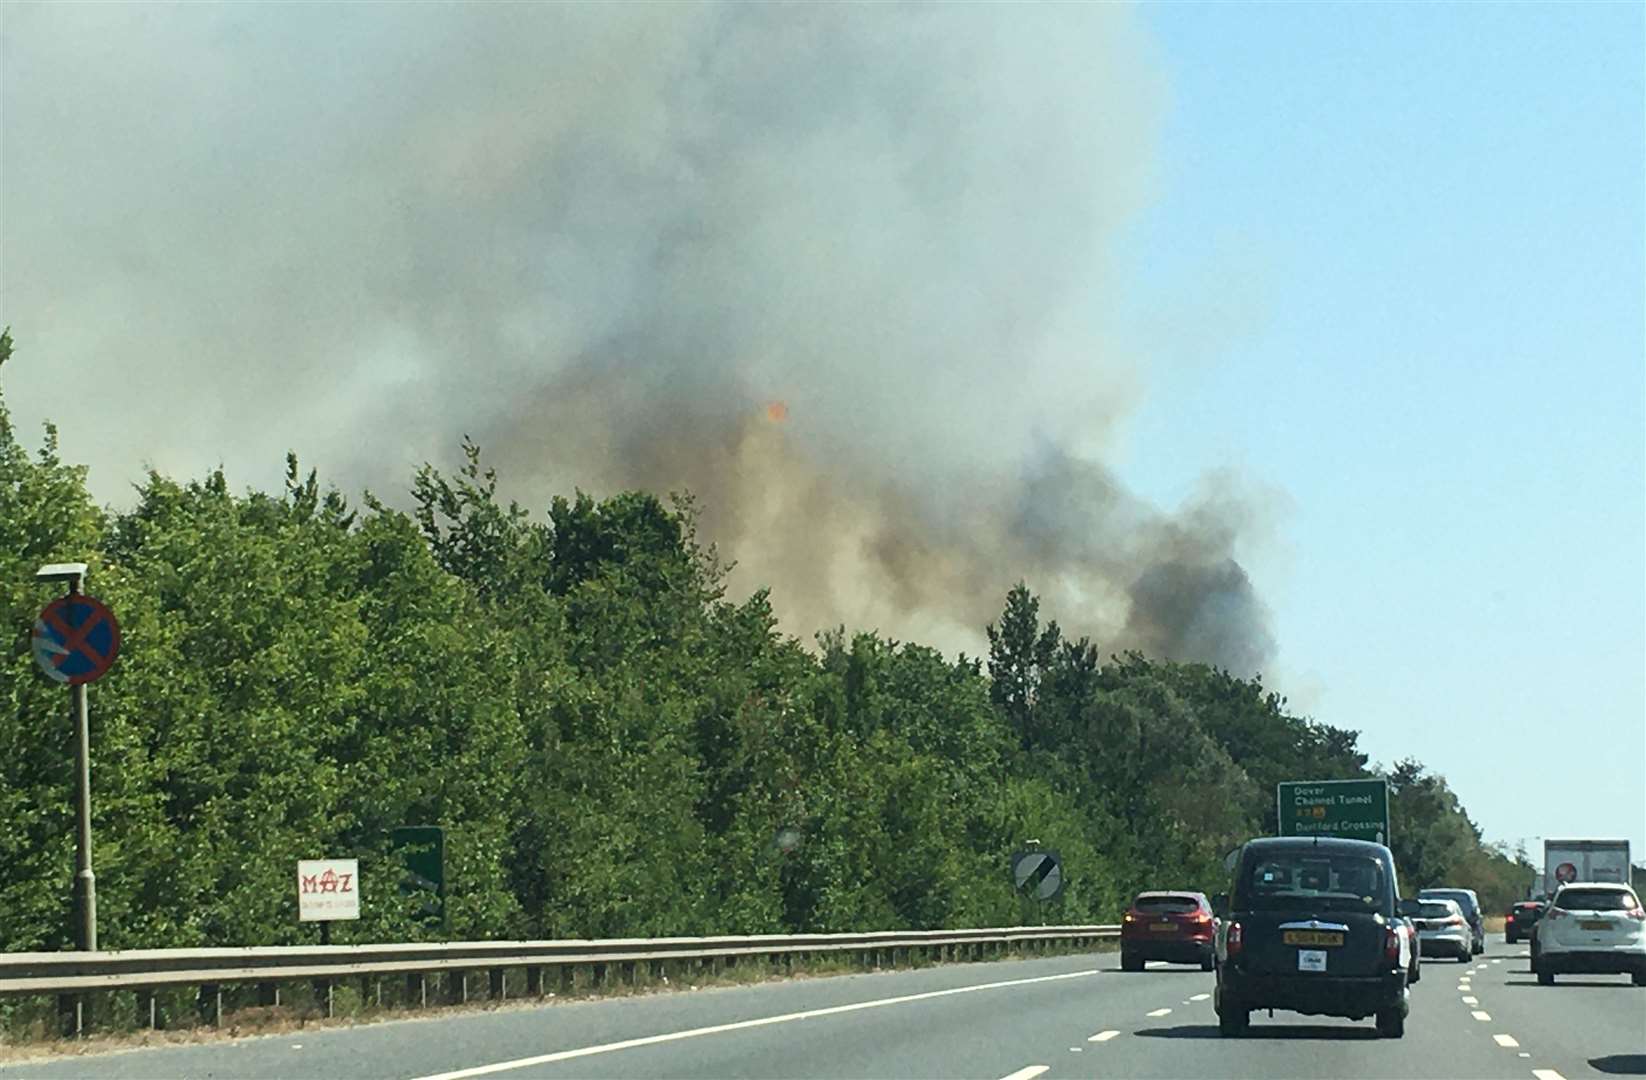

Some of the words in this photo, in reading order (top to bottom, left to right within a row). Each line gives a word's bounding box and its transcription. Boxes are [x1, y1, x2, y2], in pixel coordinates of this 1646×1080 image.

[1294, 787, 1324, 796] Dover
[1295, 796, 1335, 806] Channel
[1340, 795, 1373, 805] Tunnel
[1341, 821, 1384, 831] Crossing
[302, 868, 352, 894] MAZ
